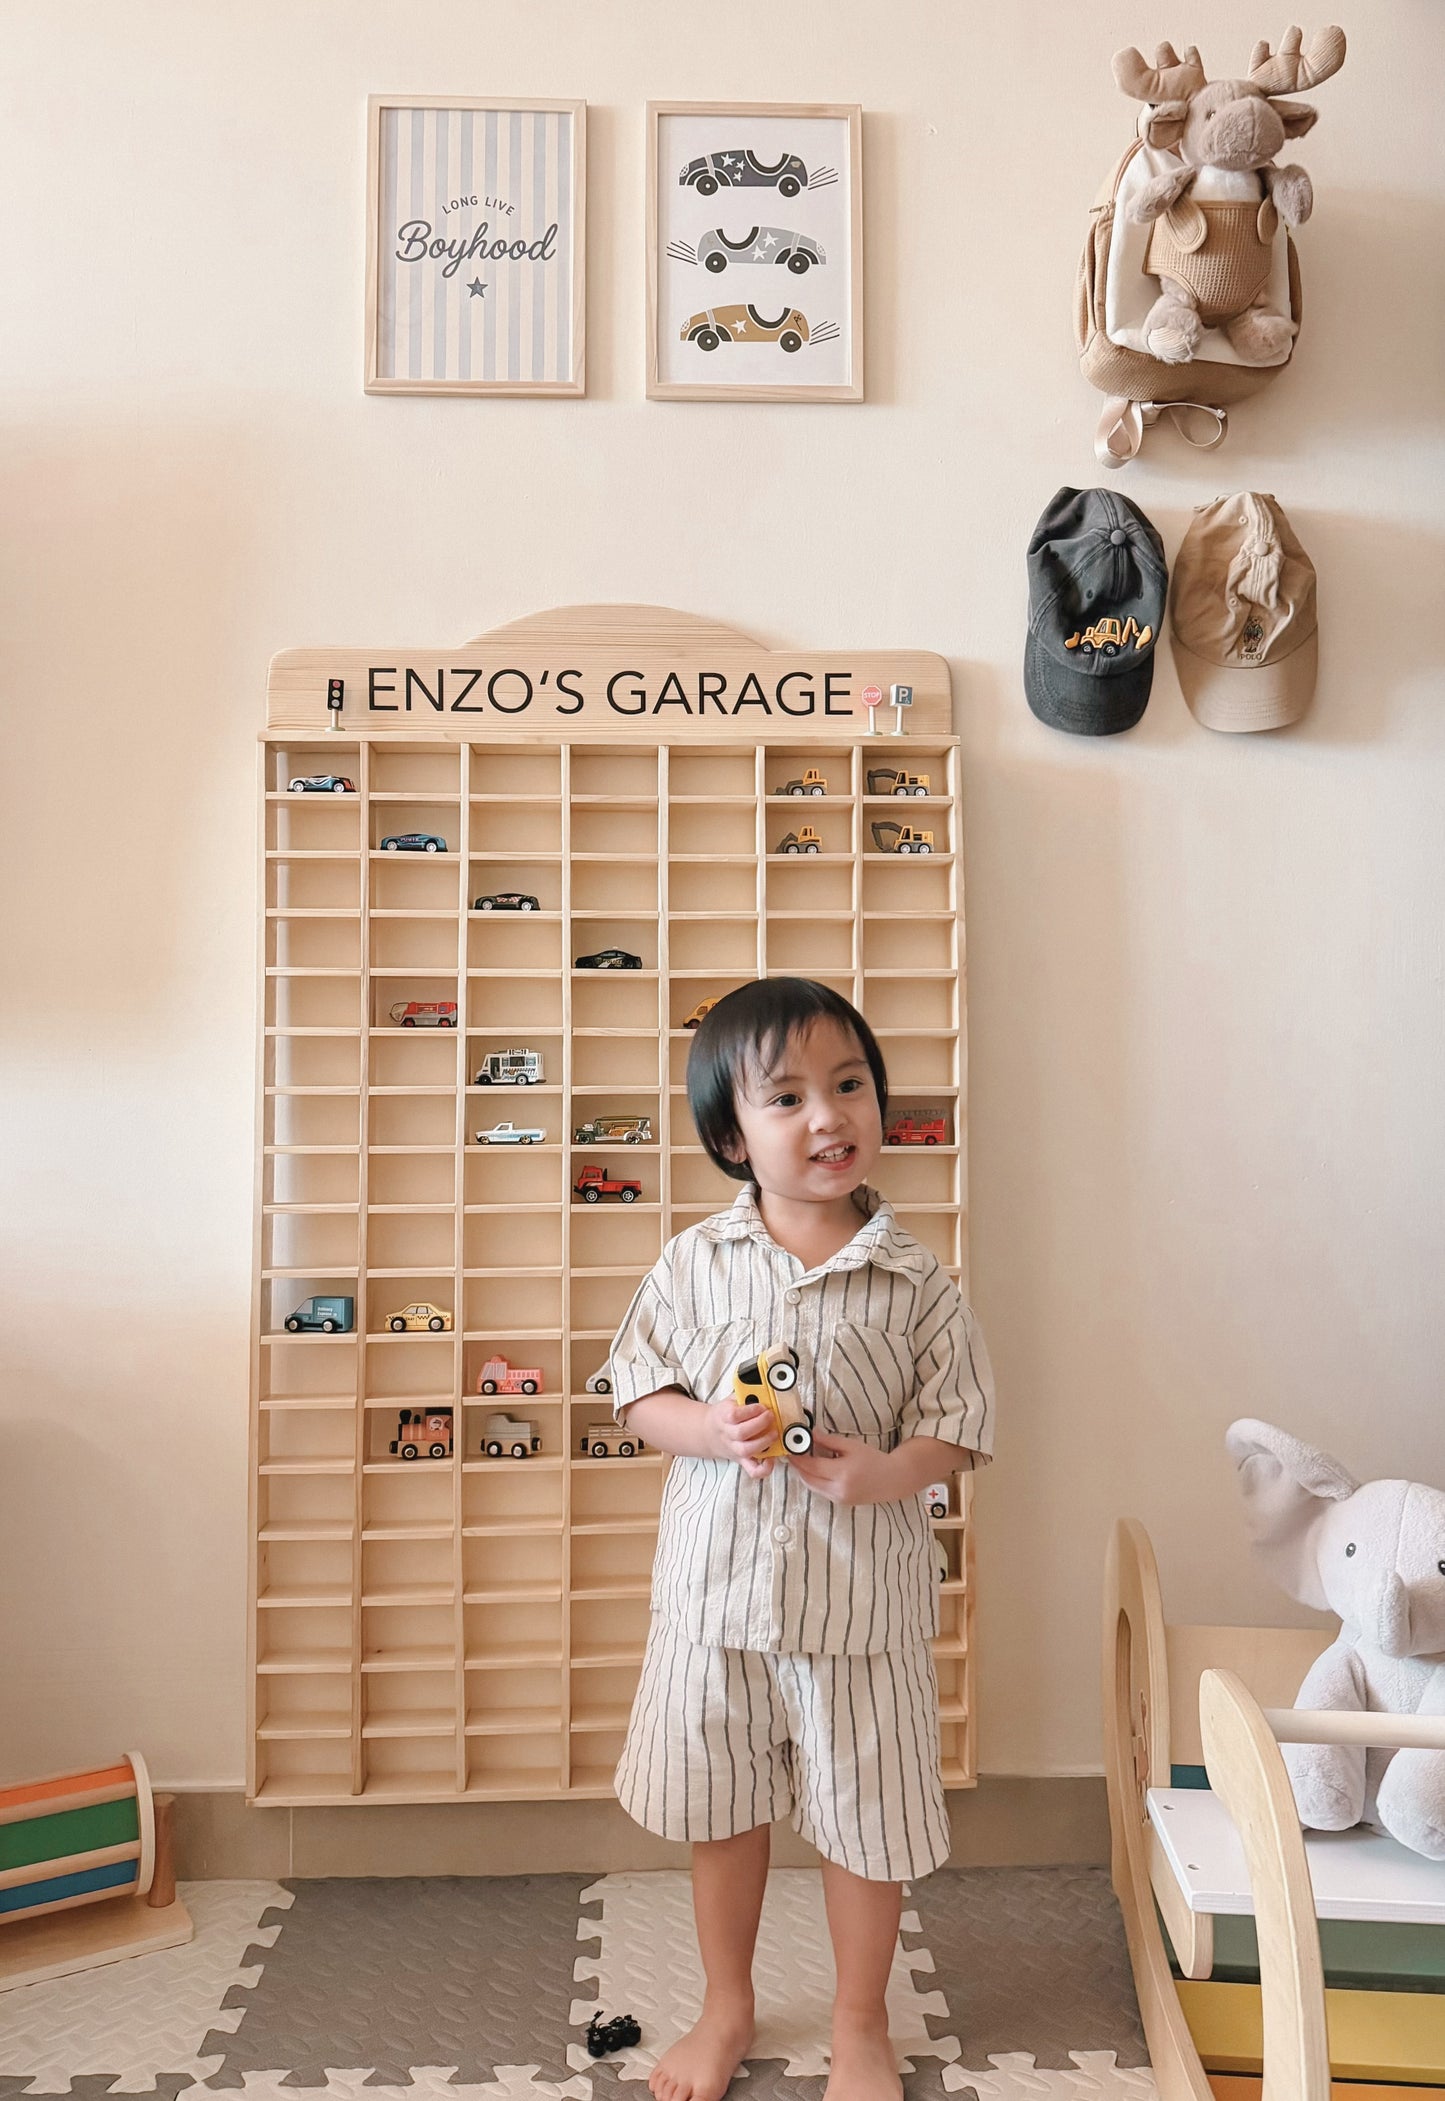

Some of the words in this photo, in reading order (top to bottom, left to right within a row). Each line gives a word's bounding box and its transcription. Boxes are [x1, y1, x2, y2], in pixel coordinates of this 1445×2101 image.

[442, 195, 479, 215] LONG
[485, 196, 515, 216] LIVE
[395, 219, 559, 279] Boyhood
[368, 667, 585, 714] ENZO'S
[607, 671, 853, 717] GARAGE
[899, 687, 909, 702] P
